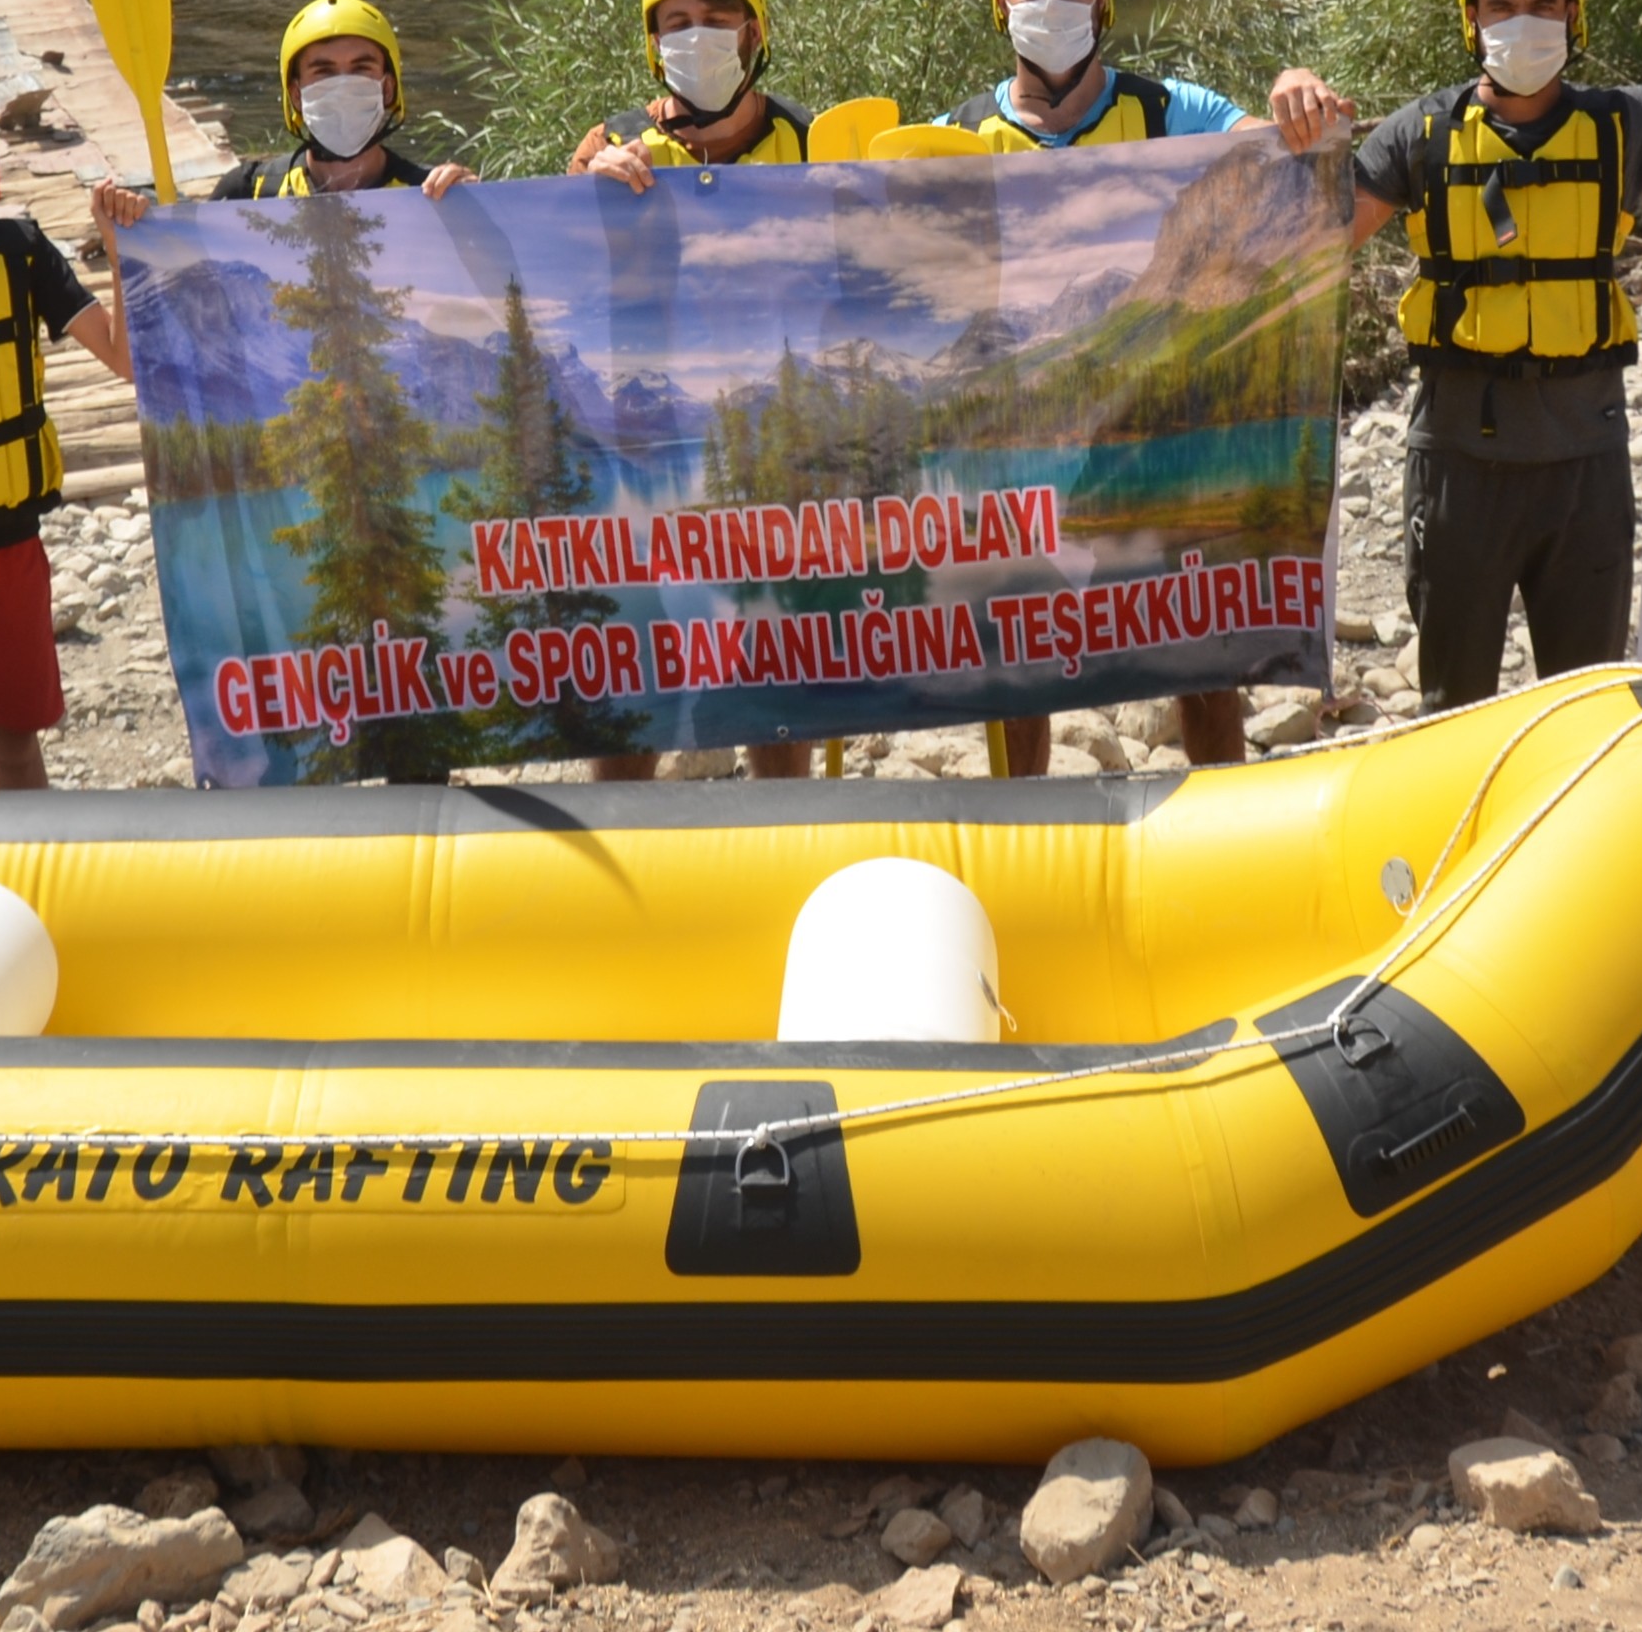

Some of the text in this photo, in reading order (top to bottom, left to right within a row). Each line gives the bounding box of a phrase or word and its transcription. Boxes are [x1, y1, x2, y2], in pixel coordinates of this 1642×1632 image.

[473, 486, 1058, 595] KATKILARINDAN DOLAYI
[216, 620, 433, 745] GENÇLİK
[438, 652, 498, 708] ve
[507, 624, 642, 706] SPOR
[650, 589, 984, 692] BAKANLIĞINA
[219, 1133, 614, 1208] RAFTING
